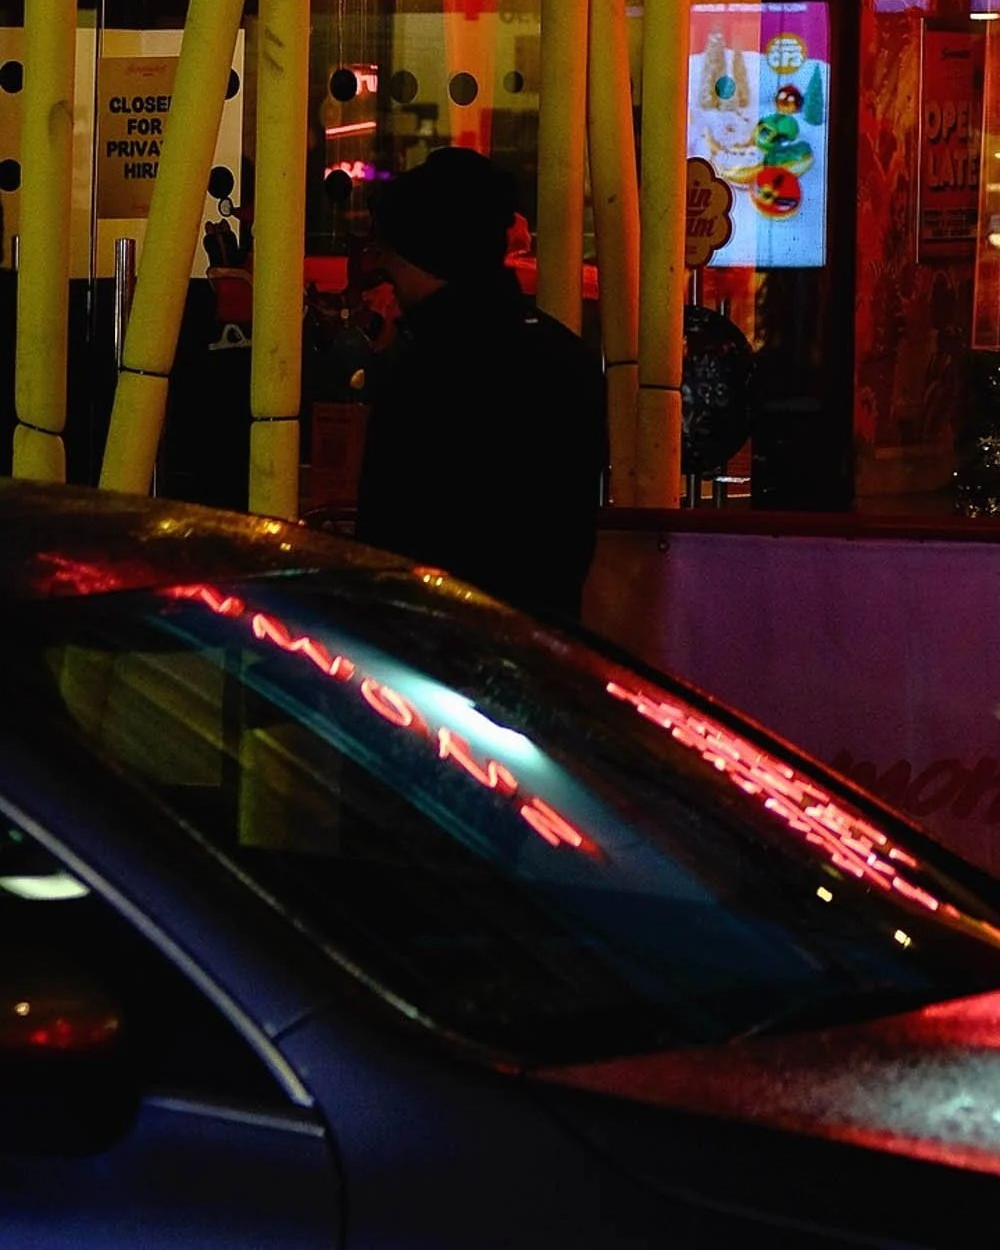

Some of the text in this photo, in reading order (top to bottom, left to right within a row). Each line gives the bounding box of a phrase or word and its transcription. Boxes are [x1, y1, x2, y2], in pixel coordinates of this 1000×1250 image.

[109, 95, 172, 114] CLOSE
[127, 118, 162, 135] FOR
[106, 141, 163, 158] PRIVA
[124, 162, 159, 180] HIR
